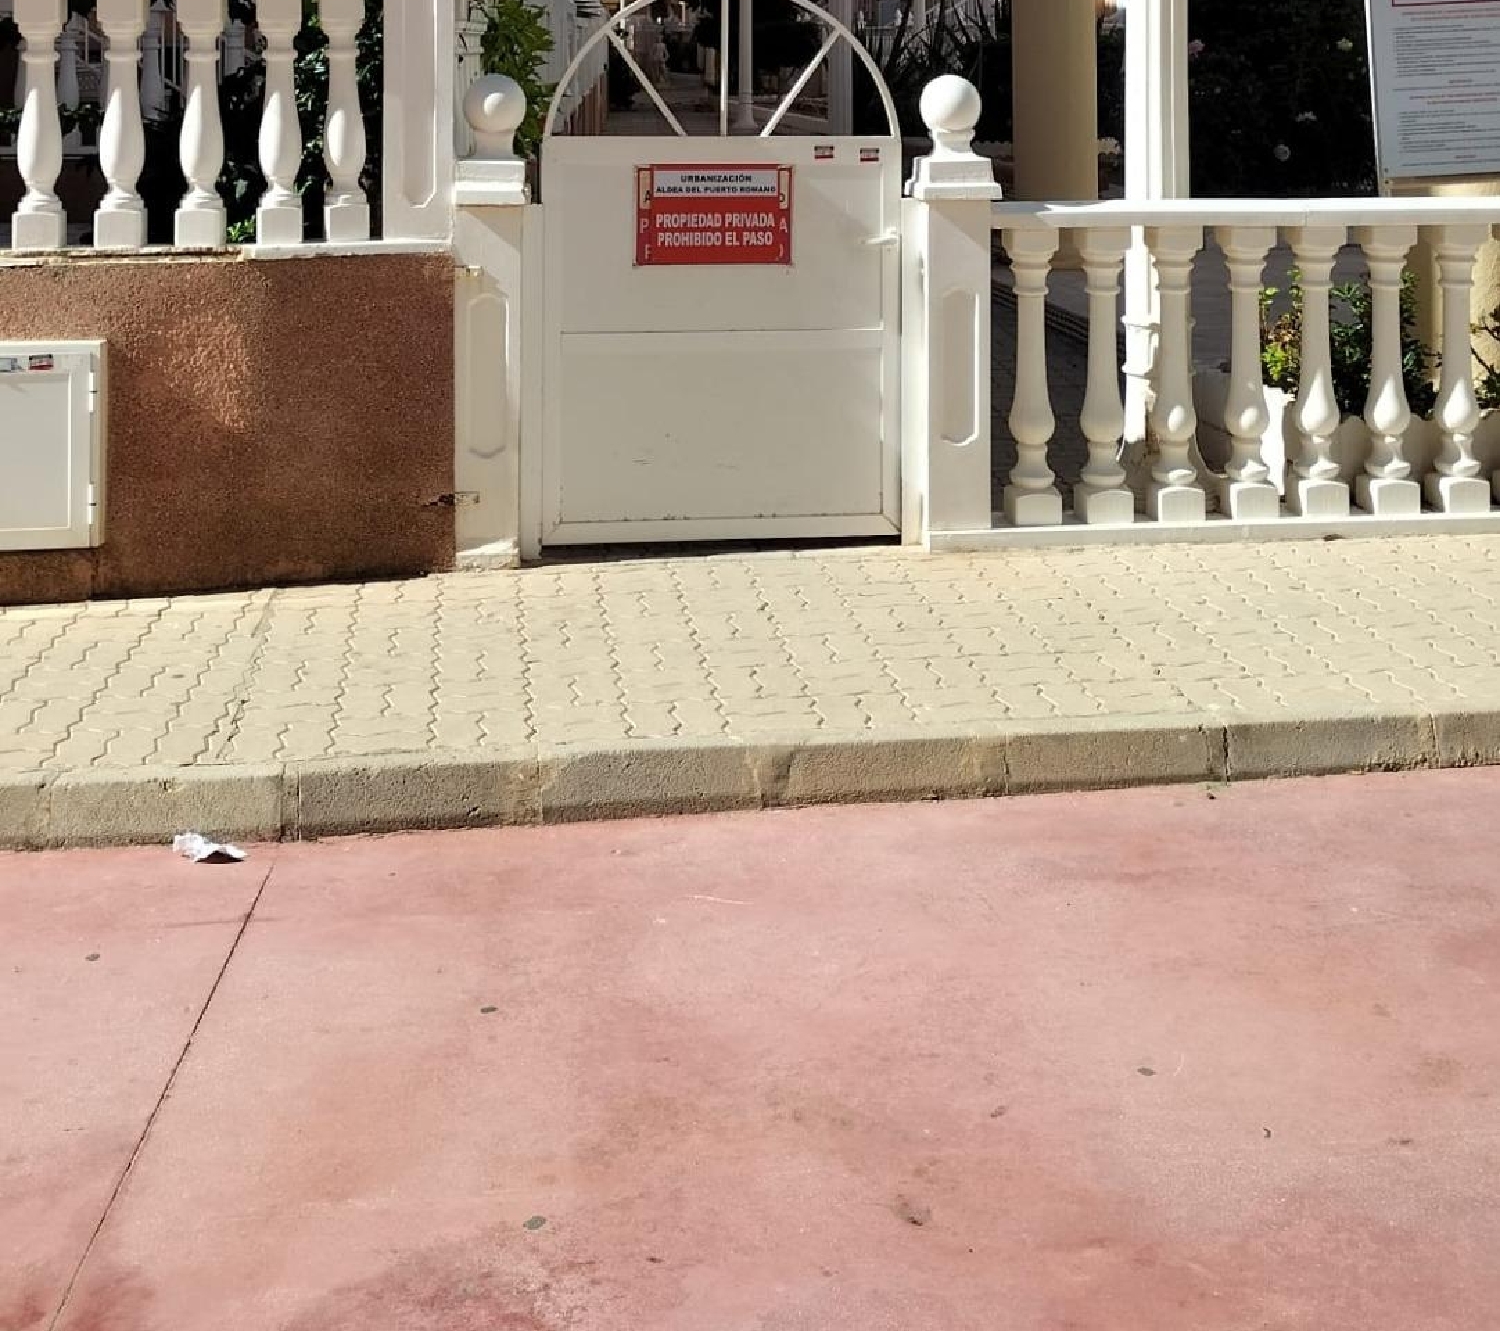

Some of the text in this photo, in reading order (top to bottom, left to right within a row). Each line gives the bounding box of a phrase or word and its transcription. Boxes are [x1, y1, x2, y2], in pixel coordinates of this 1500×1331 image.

[680, 173, 752, 183] URBANIZACIÓN
[656, 185, 776, 194] ALDEA DEL PUERTO ROMANO
[655, 213, 722, 228] PROPIEDAD
[724, 213, 776, 227] PRIVADA
[657, 231, 773, 247] PROHIBIDO EL PASO
